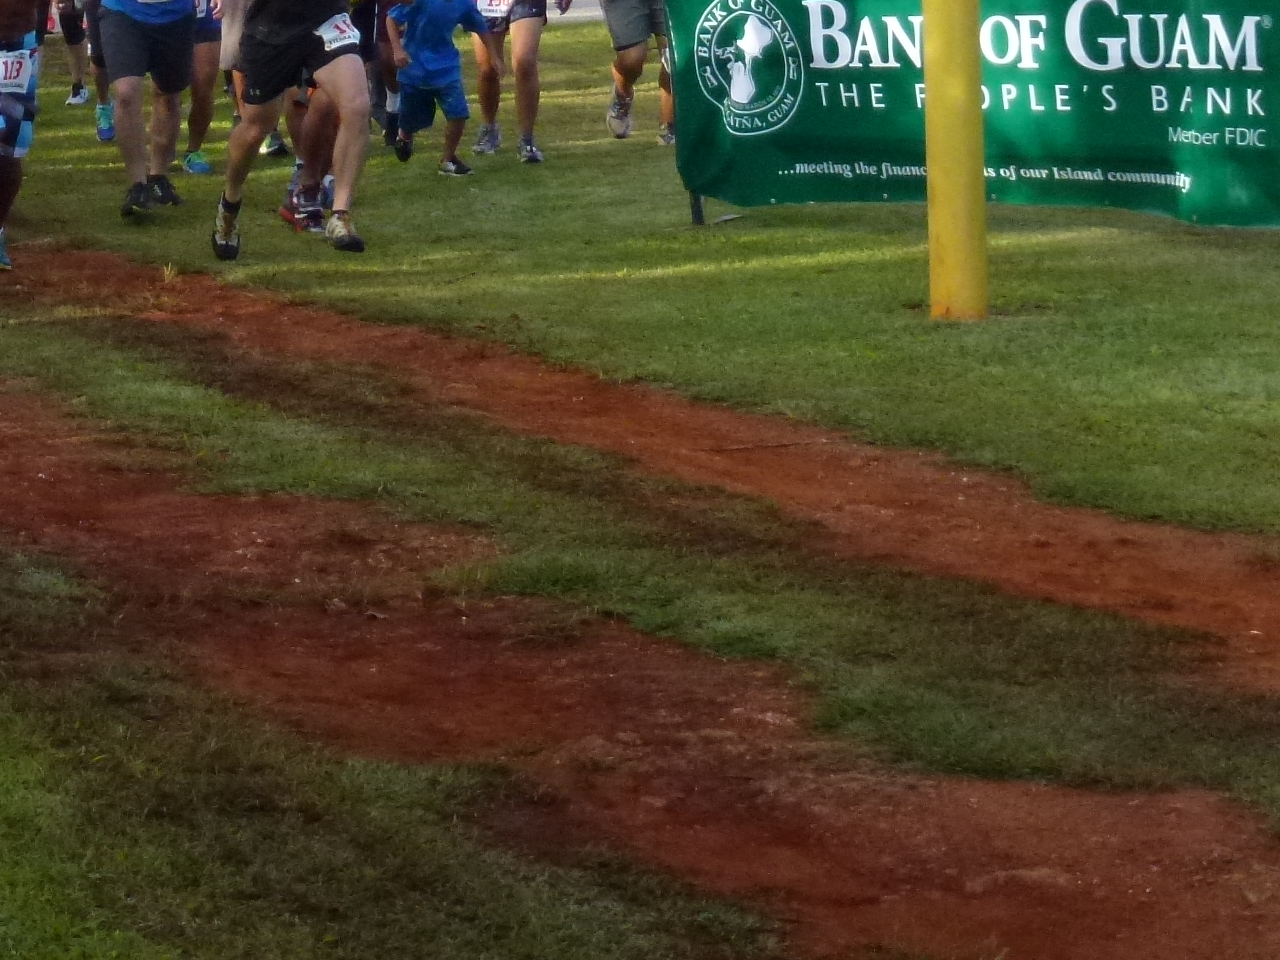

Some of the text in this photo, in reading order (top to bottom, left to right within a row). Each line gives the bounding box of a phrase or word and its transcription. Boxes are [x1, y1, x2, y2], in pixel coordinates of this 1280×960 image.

[698, 2, 727, 58] BANK
[979, 14, 1047, 70] OF
[2, 59, 23, 81] 113
[767, 92, 795, 122] GUAM
[815, 82, 886, 109] THE
[914, 82, 1118, 112] PPLE'S
[1150, 84, 1265, 117] BANK
[1225, 127, 1267, 148] FDIC
[855, 161, 878, 175] the
[1000, 165, 1016, 180] of
[1020, 166, 1049, 179] our
[1052, 166, 1104, 182] Island
